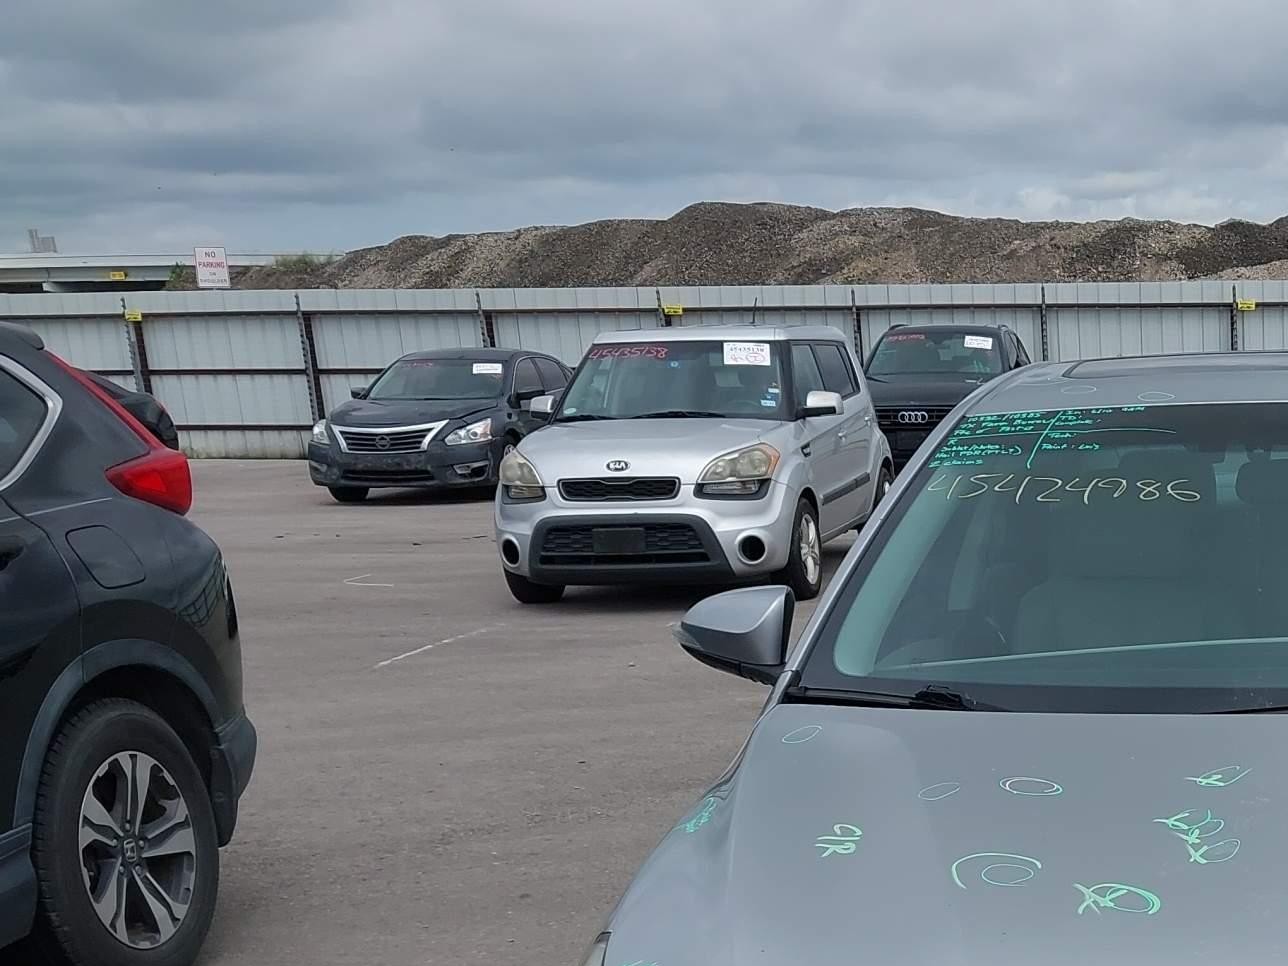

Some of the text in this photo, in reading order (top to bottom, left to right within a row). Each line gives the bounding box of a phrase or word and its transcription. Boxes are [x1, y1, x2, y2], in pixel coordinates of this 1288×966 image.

[198, 261, 225, 269] PARKING
[589, 346, 669, 359] 45435138
[927, 474, 1201, 504] 45424986
